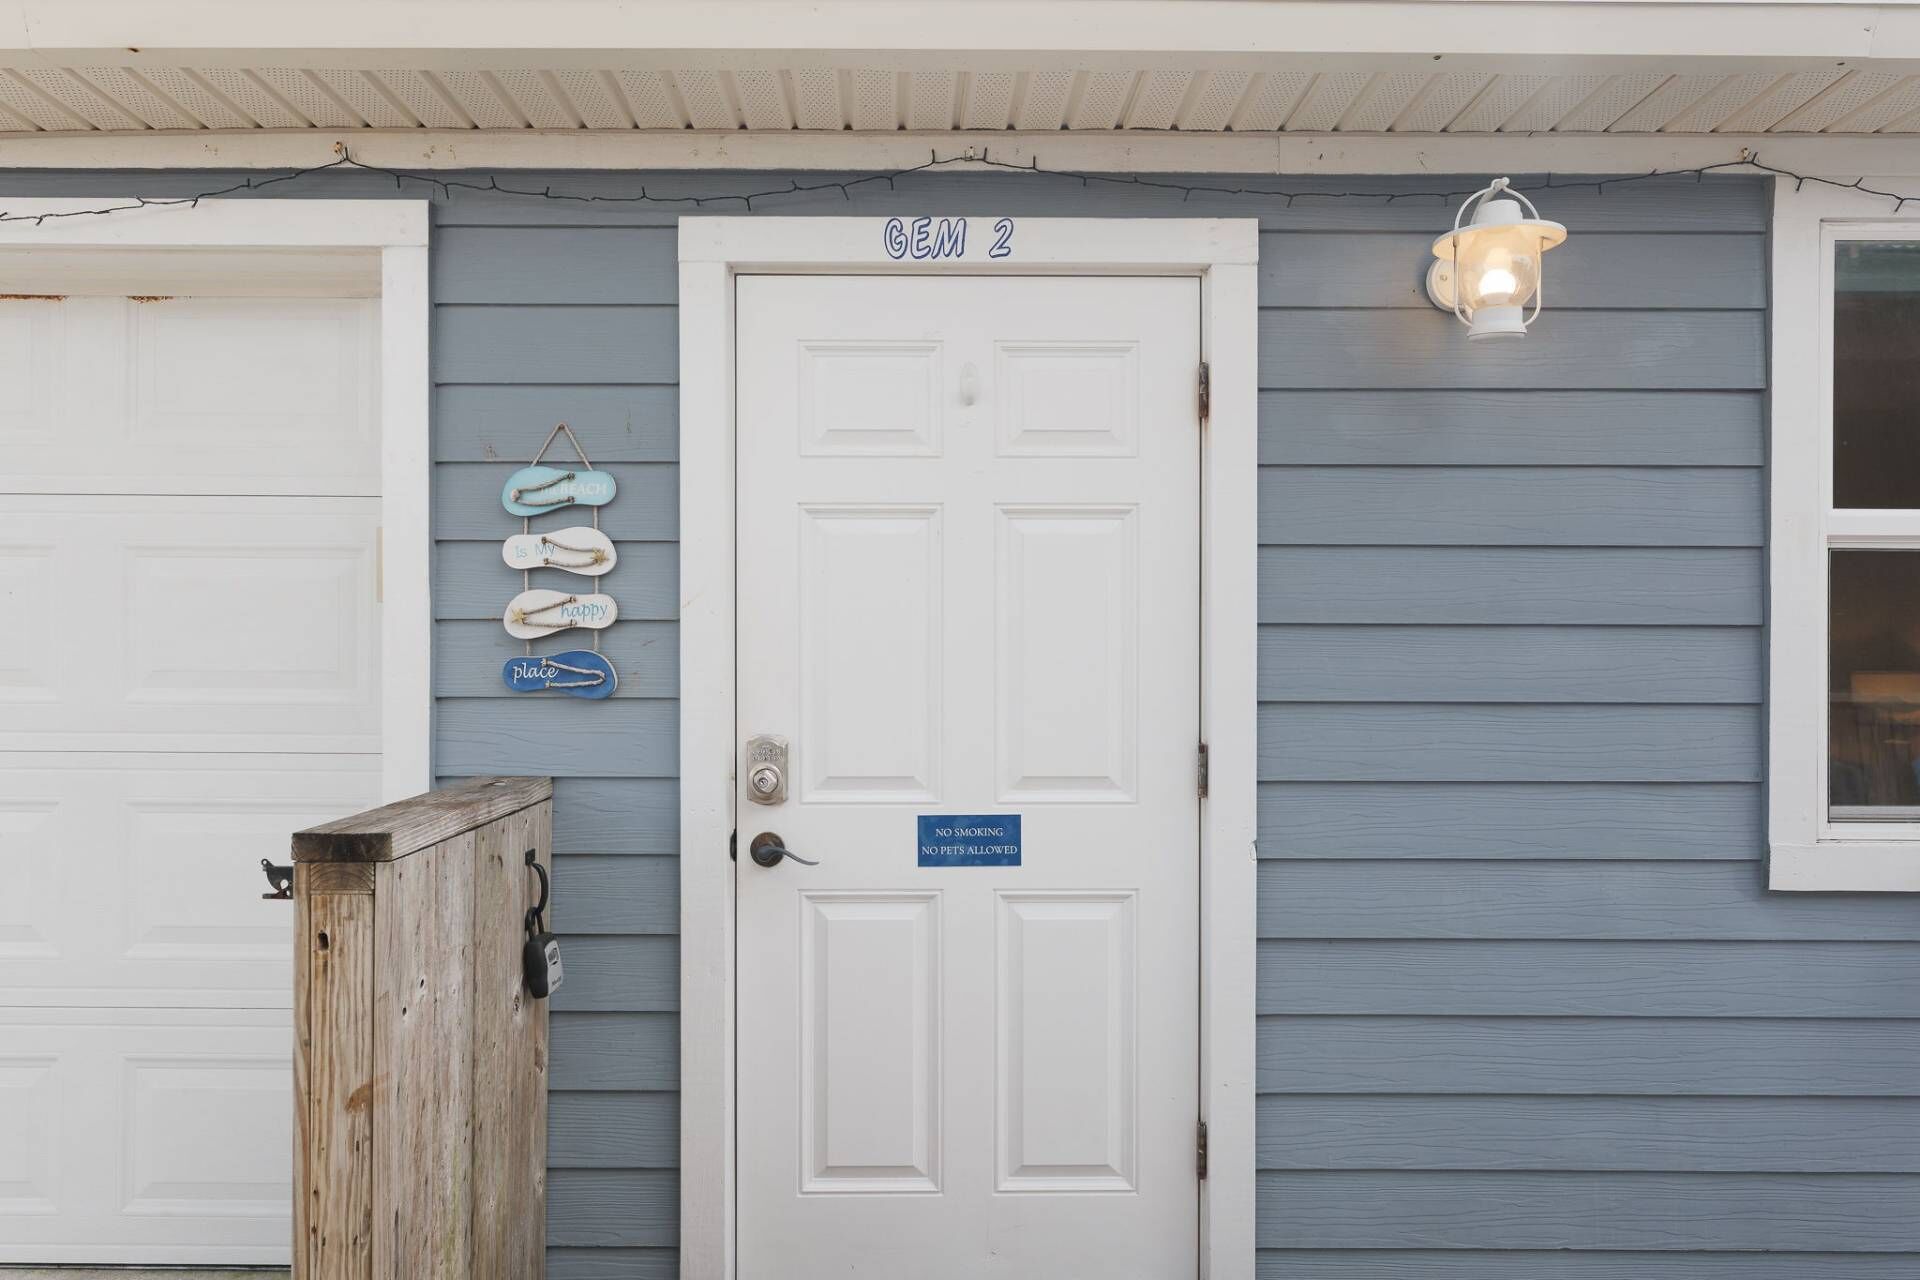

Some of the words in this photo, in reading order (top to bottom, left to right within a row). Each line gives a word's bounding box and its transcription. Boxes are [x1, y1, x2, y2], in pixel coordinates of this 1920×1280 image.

[884, 217, 967, 259] GEM
[989, 218, 1014, 258] 2
[560, 483, 608, 496] BEACH
[535, 543, 555, 557] My
[560, 602, 608, 622] happy
[513, 662, 559, 683] place
[936, 828, 952, 837] NO
[954, 828, 1003, 837] SMOKING
[922, 846, 939, 855] NO
[941, 846, 966, 855] PETS
[967, 845, 1018, 855] ALLOWED
